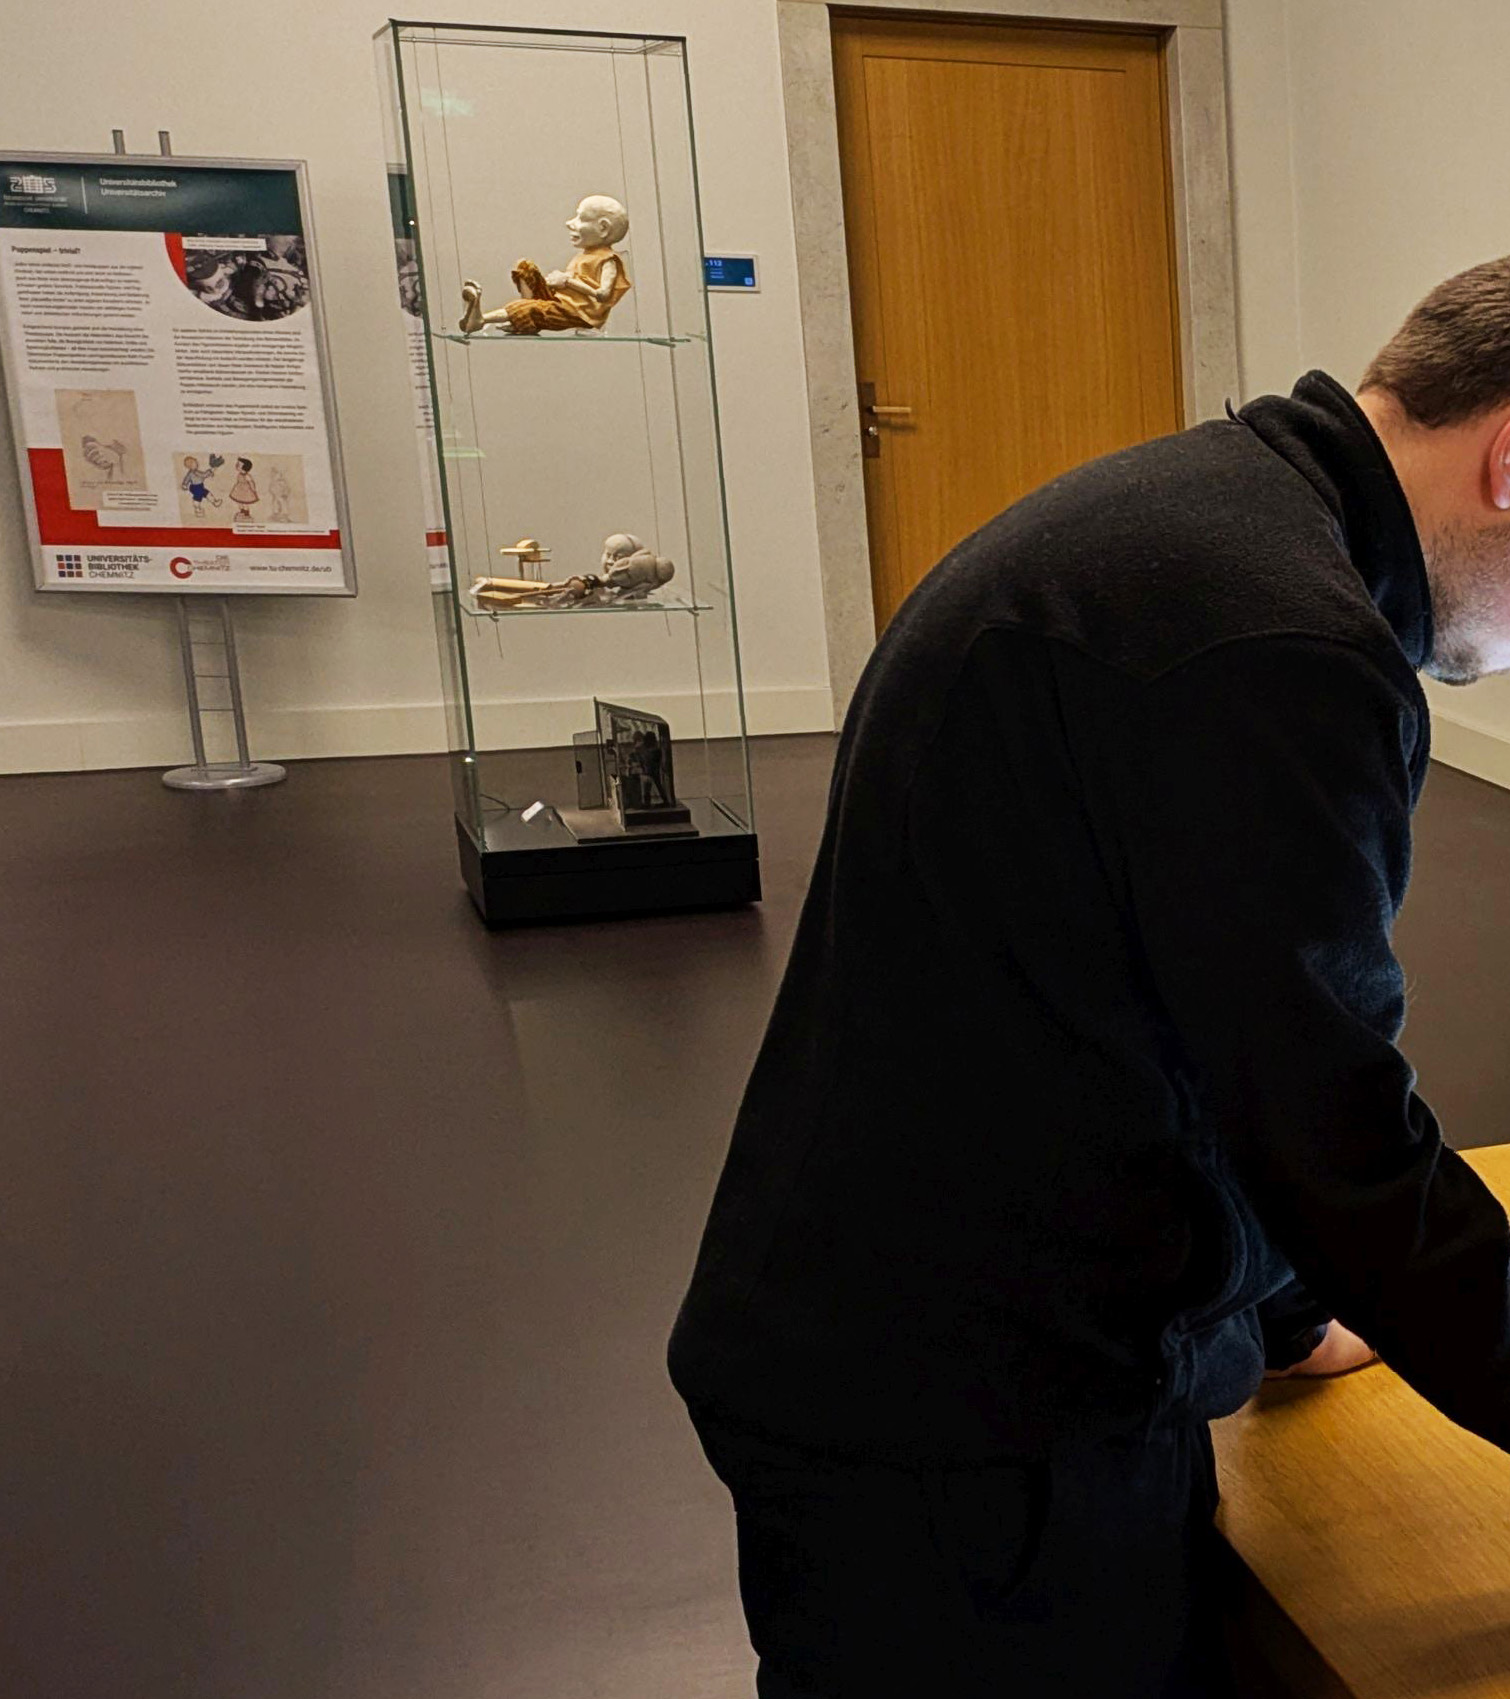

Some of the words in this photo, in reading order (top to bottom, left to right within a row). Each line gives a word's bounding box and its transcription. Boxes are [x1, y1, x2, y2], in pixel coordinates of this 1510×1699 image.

[100, 188, 166, 197] Universitätsarchiv
[11, 245, 51, 254] Puppenspiel
[86, 554, 152, 563] UNIVERSITÄTS-
[88, 562, 139, 571] BIBLIOTHEK
